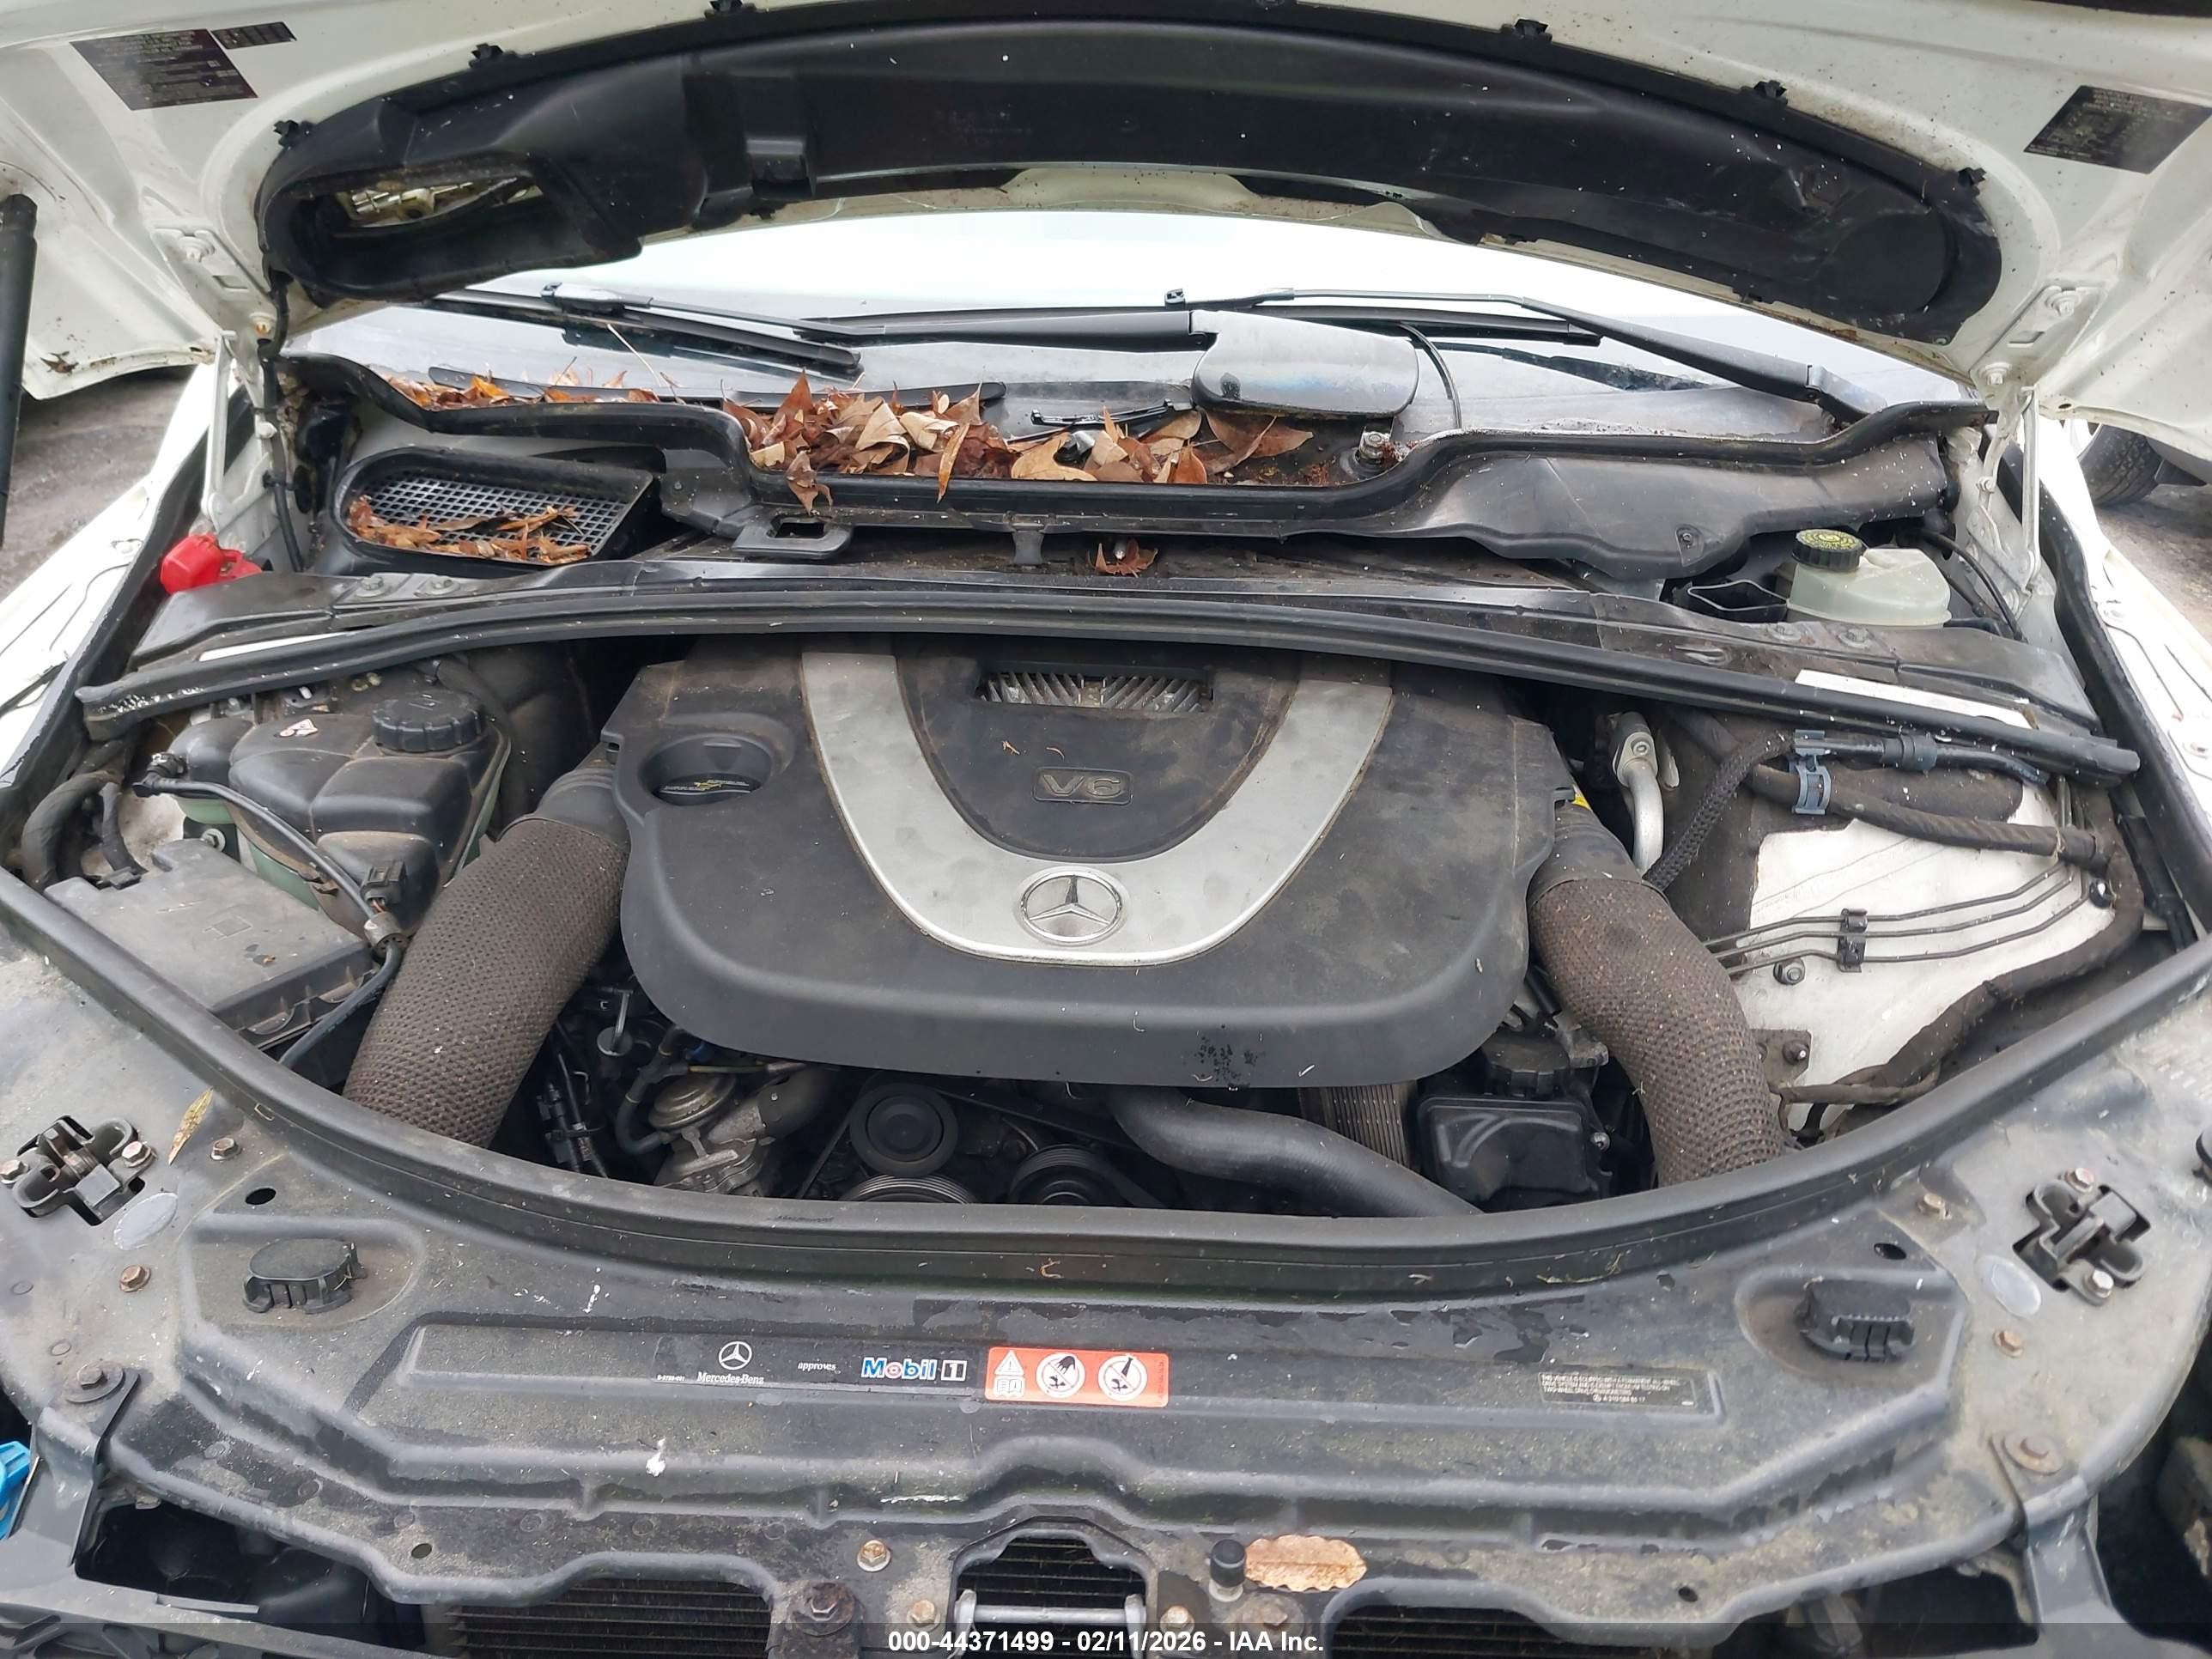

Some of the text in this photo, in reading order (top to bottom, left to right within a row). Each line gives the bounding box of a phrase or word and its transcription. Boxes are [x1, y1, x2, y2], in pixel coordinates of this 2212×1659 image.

[1042, 774, 1124, 799] V6
[797, 1361, 837, 1372] approves
[861, 1357, 968, 1381] Mobil 1
[696, 1370, 765, 1385] Mercedes-Benz
